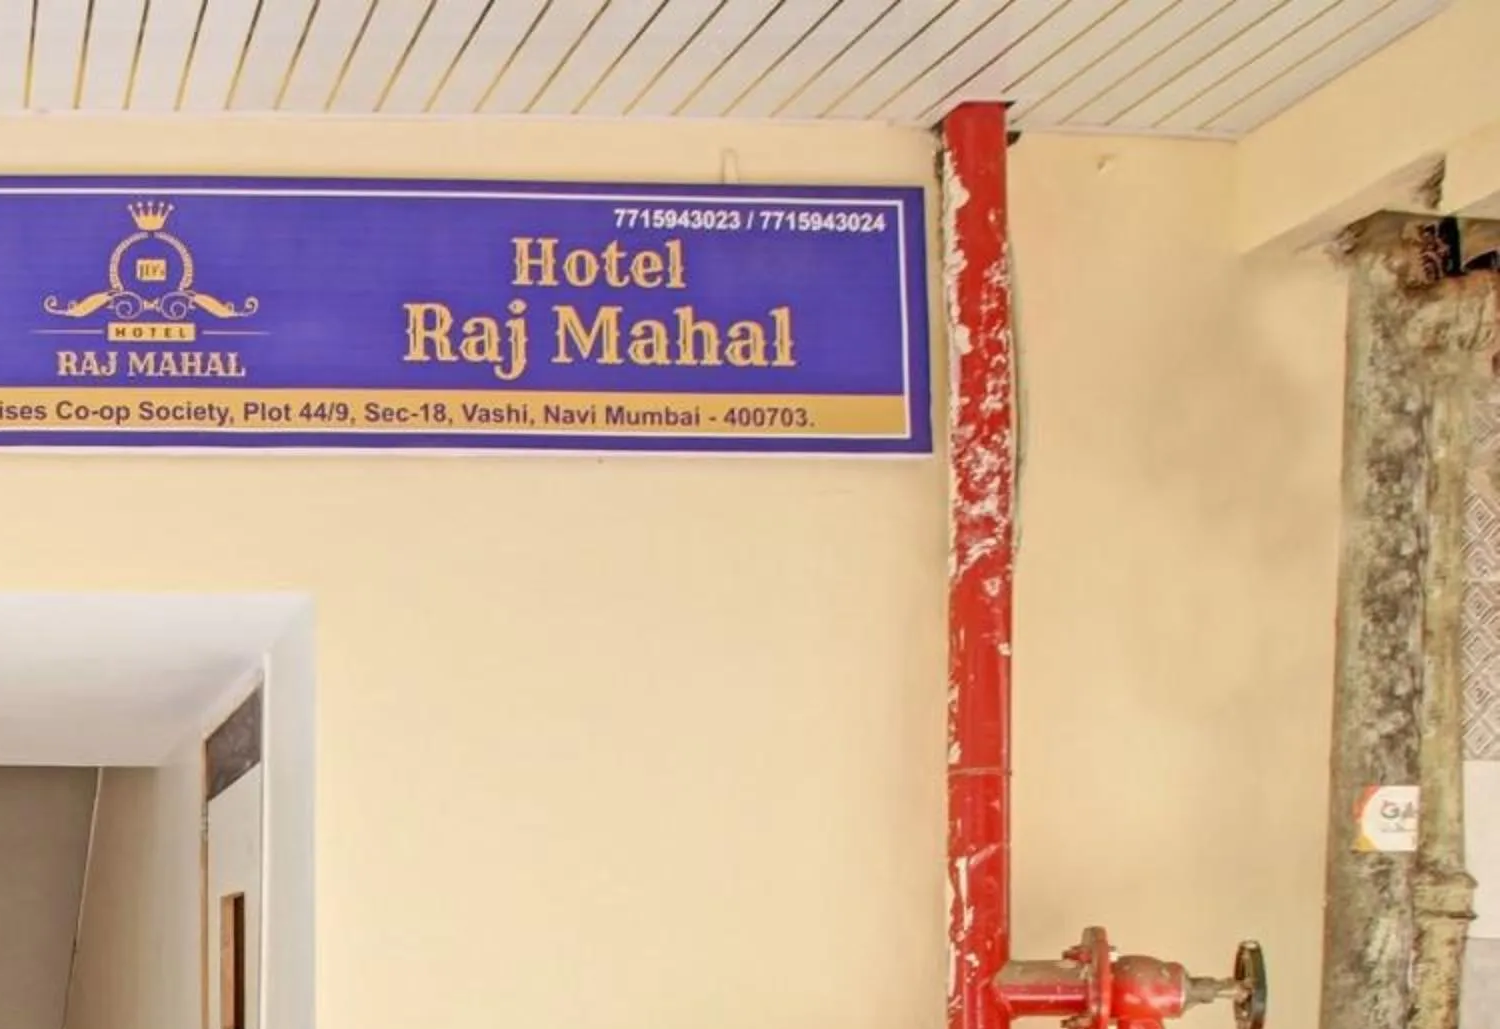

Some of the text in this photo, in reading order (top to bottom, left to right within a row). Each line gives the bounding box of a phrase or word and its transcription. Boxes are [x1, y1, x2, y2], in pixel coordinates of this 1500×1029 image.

[613, 208, 741, 229] 7715943023
[759, 211, 886, 232] 7715943024
[511, 237, 687, 288] Hotel
[114, 327, 188, 339] HOTEL
[402, 299, 796, 381] Raj Mahal
[57, 351, 246, 377] RAJ MAHAL
[55, 401, 131, 424] Co-op
[138, 401, 235, 426] Society,
[243, 402, 292, 421] Plot
[299, 402, 356, 424] 44/9,
[364, 403, 453, 425] Sec-18,
[462, 404, 535, 425] Vashi,
[543, 405, 596, 424] Navi
[605, 405, 700, 426] Mumbai
[723, 407, 815, 427] 400703.
